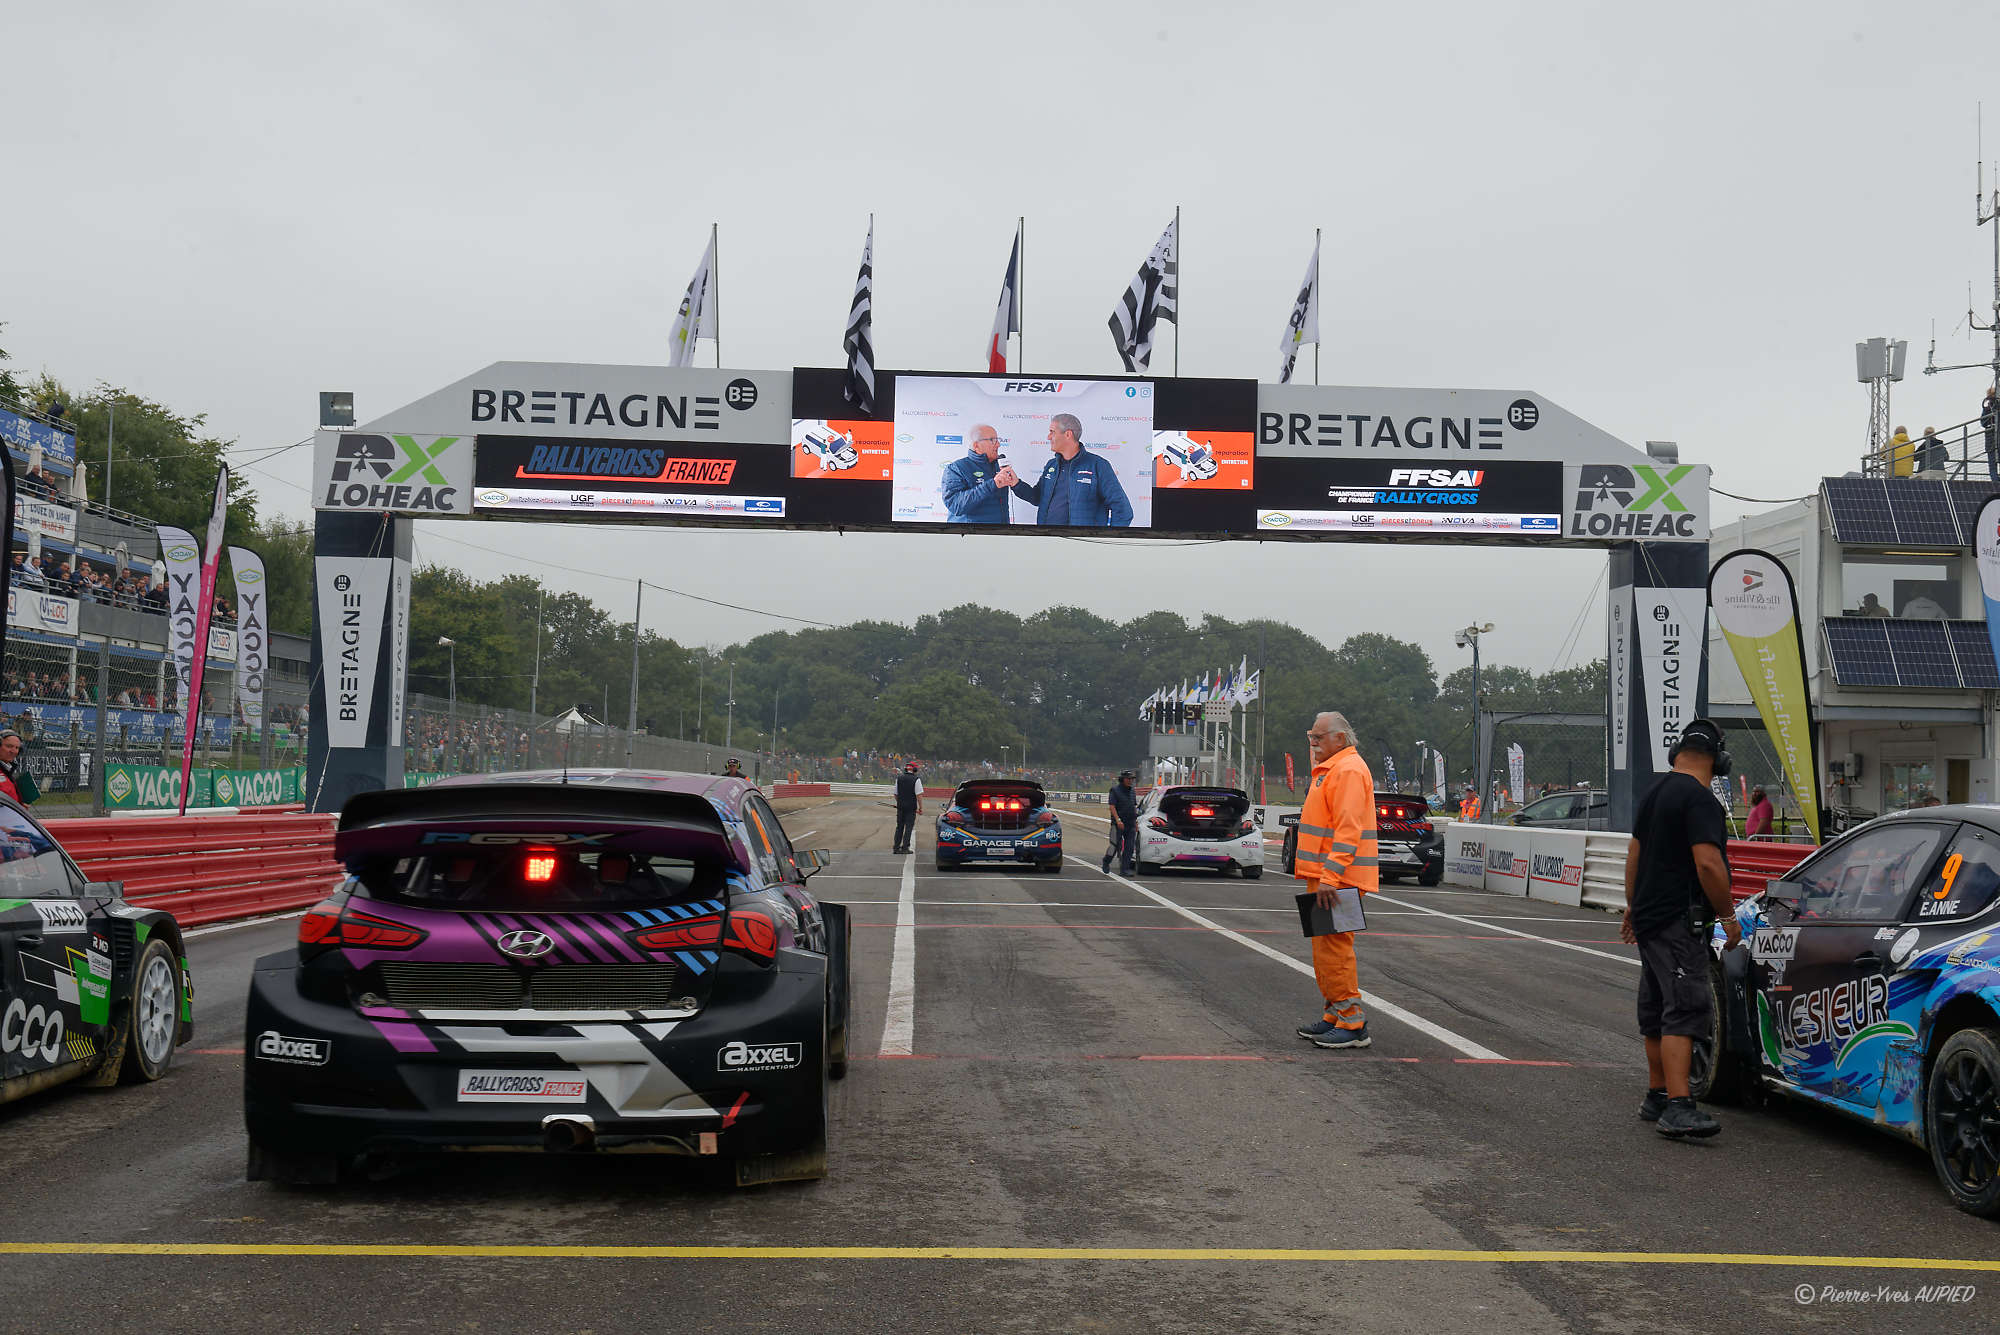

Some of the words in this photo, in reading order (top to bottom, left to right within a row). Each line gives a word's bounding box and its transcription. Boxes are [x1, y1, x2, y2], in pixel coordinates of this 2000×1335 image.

[1005, 382, 1056, 393] FFSA
[472, 390, 719, 430] BRETAGNE
[1260, 413, 1502, 450] BRETAGNE
[528, 445, 664, 475] RALLYCROSS
[665, 461, 732, 482] FRANCE
[1389, 469, 1473, 487] FFSA
[325, 484, 457, 511] LOHEAC
[1374, 491, 1478, 505] RALLYCROSS
[1571, 513, 1695, 537] LOHEAC
[339, 594, 361, 721] BRETAGNE
[1663, 623, 1680, 748] BRETAGNE
[235, 771, 282, 806] YACCO
[963, 839, 1011, 848] GARAGE
[1015, 839, 1038, 848] PEU
[1461, 841, 1481, 859] FFSA
[1533, 853, 1564, 879] RALLYCROSS
[1934, 853, 1963, 899] 9
[39, 905, 85, 927] YACCO
[1920, 900, 1960, 916] E.ANNE
[1757, 934, 1793, 954] YACCO
[1776, 973, 1889, 1050] LESIEUR
[466, 1076, 545, 1092] RALLYCROSS
[544, 1082, 584, 1095] FRANCE
